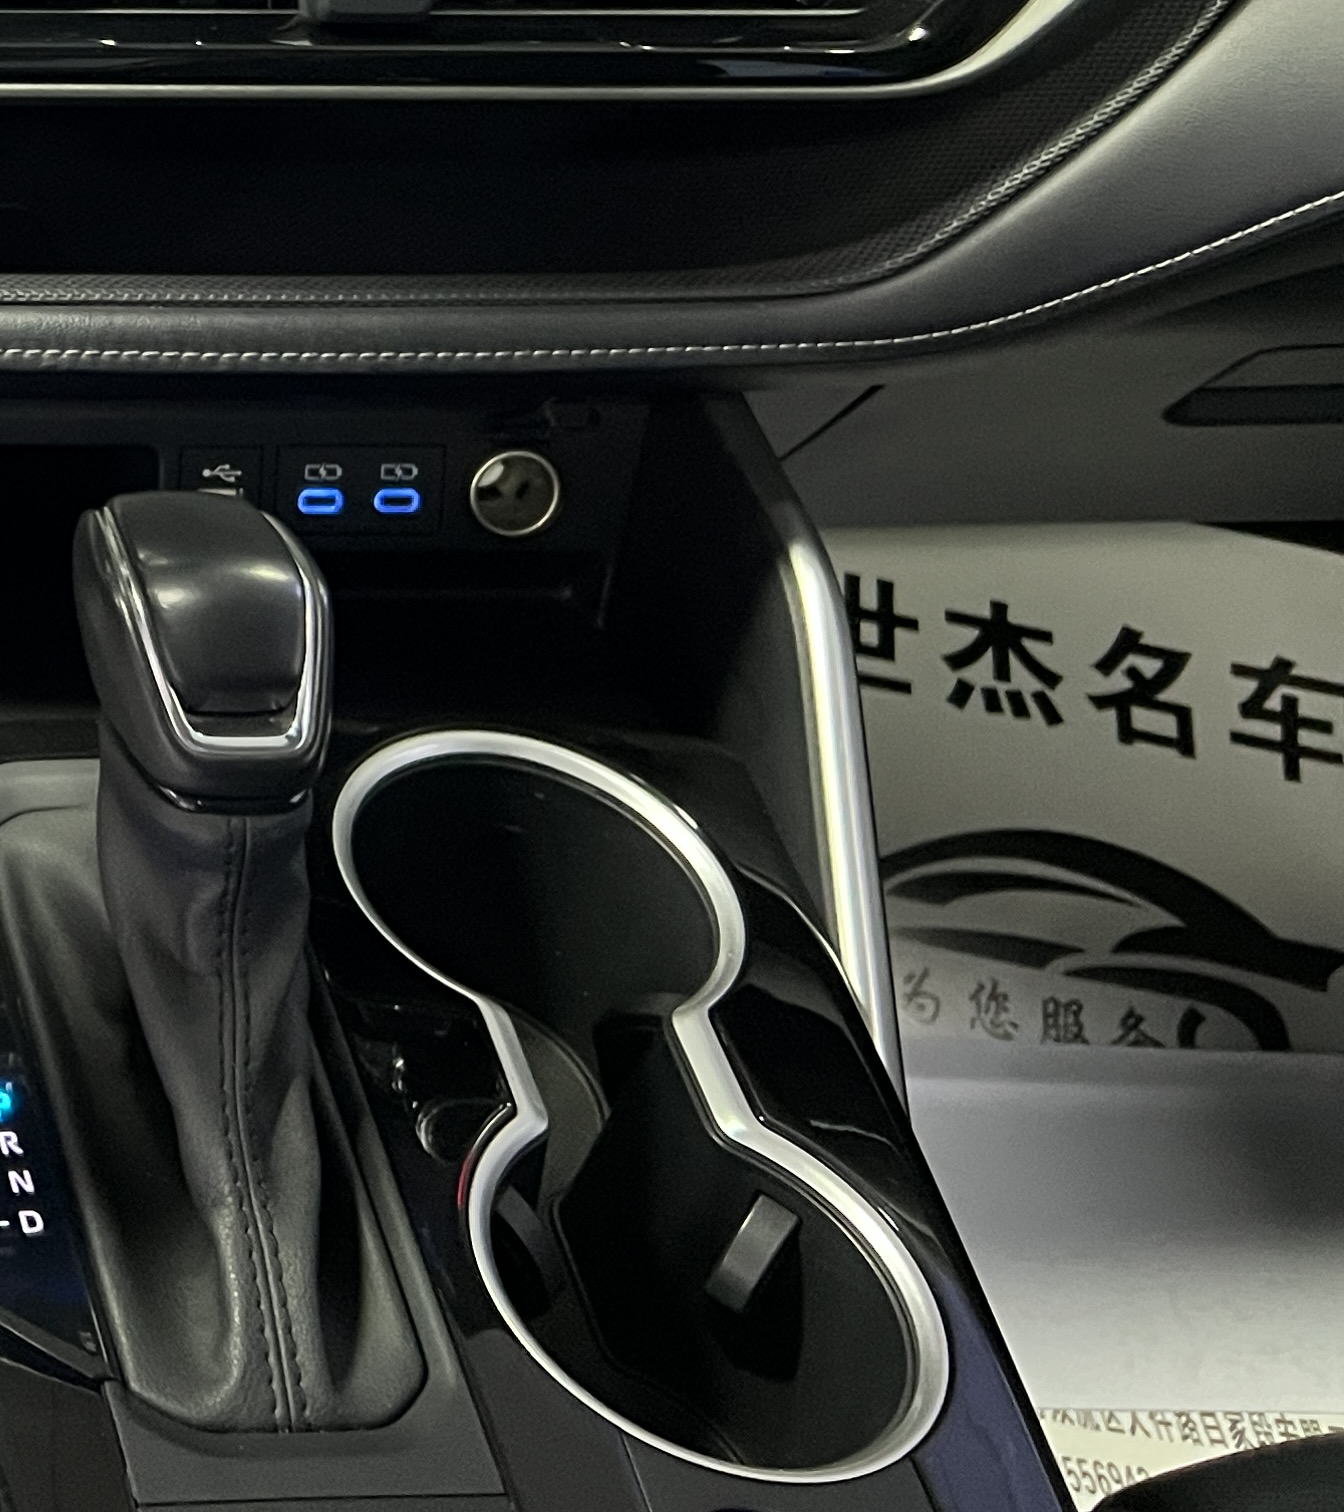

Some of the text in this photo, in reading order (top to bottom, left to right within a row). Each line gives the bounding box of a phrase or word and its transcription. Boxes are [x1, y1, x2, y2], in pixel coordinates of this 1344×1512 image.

[842, 571, 1344, 782] 世杰名车
[8, 1170, 35, 1195] N
[18, 1210, 44, 1235] D
